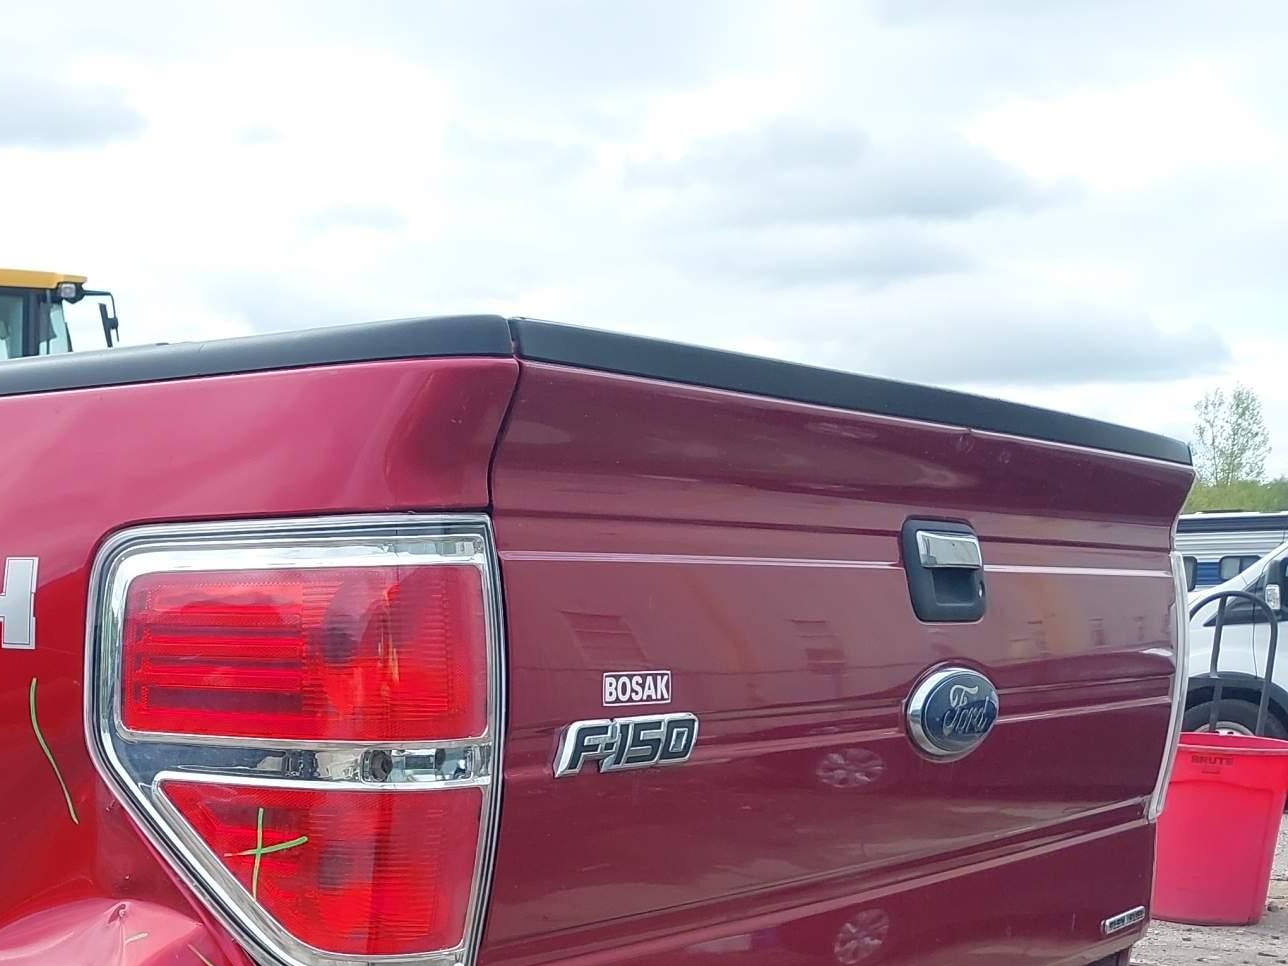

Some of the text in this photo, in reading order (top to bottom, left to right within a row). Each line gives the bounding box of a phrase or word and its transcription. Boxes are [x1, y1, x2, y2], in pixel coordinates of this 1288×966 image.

[605, 674, 669, 702] BOSAK
[943, 684, 990, 737] Ford
[553, 712, 699, 778] F-150
